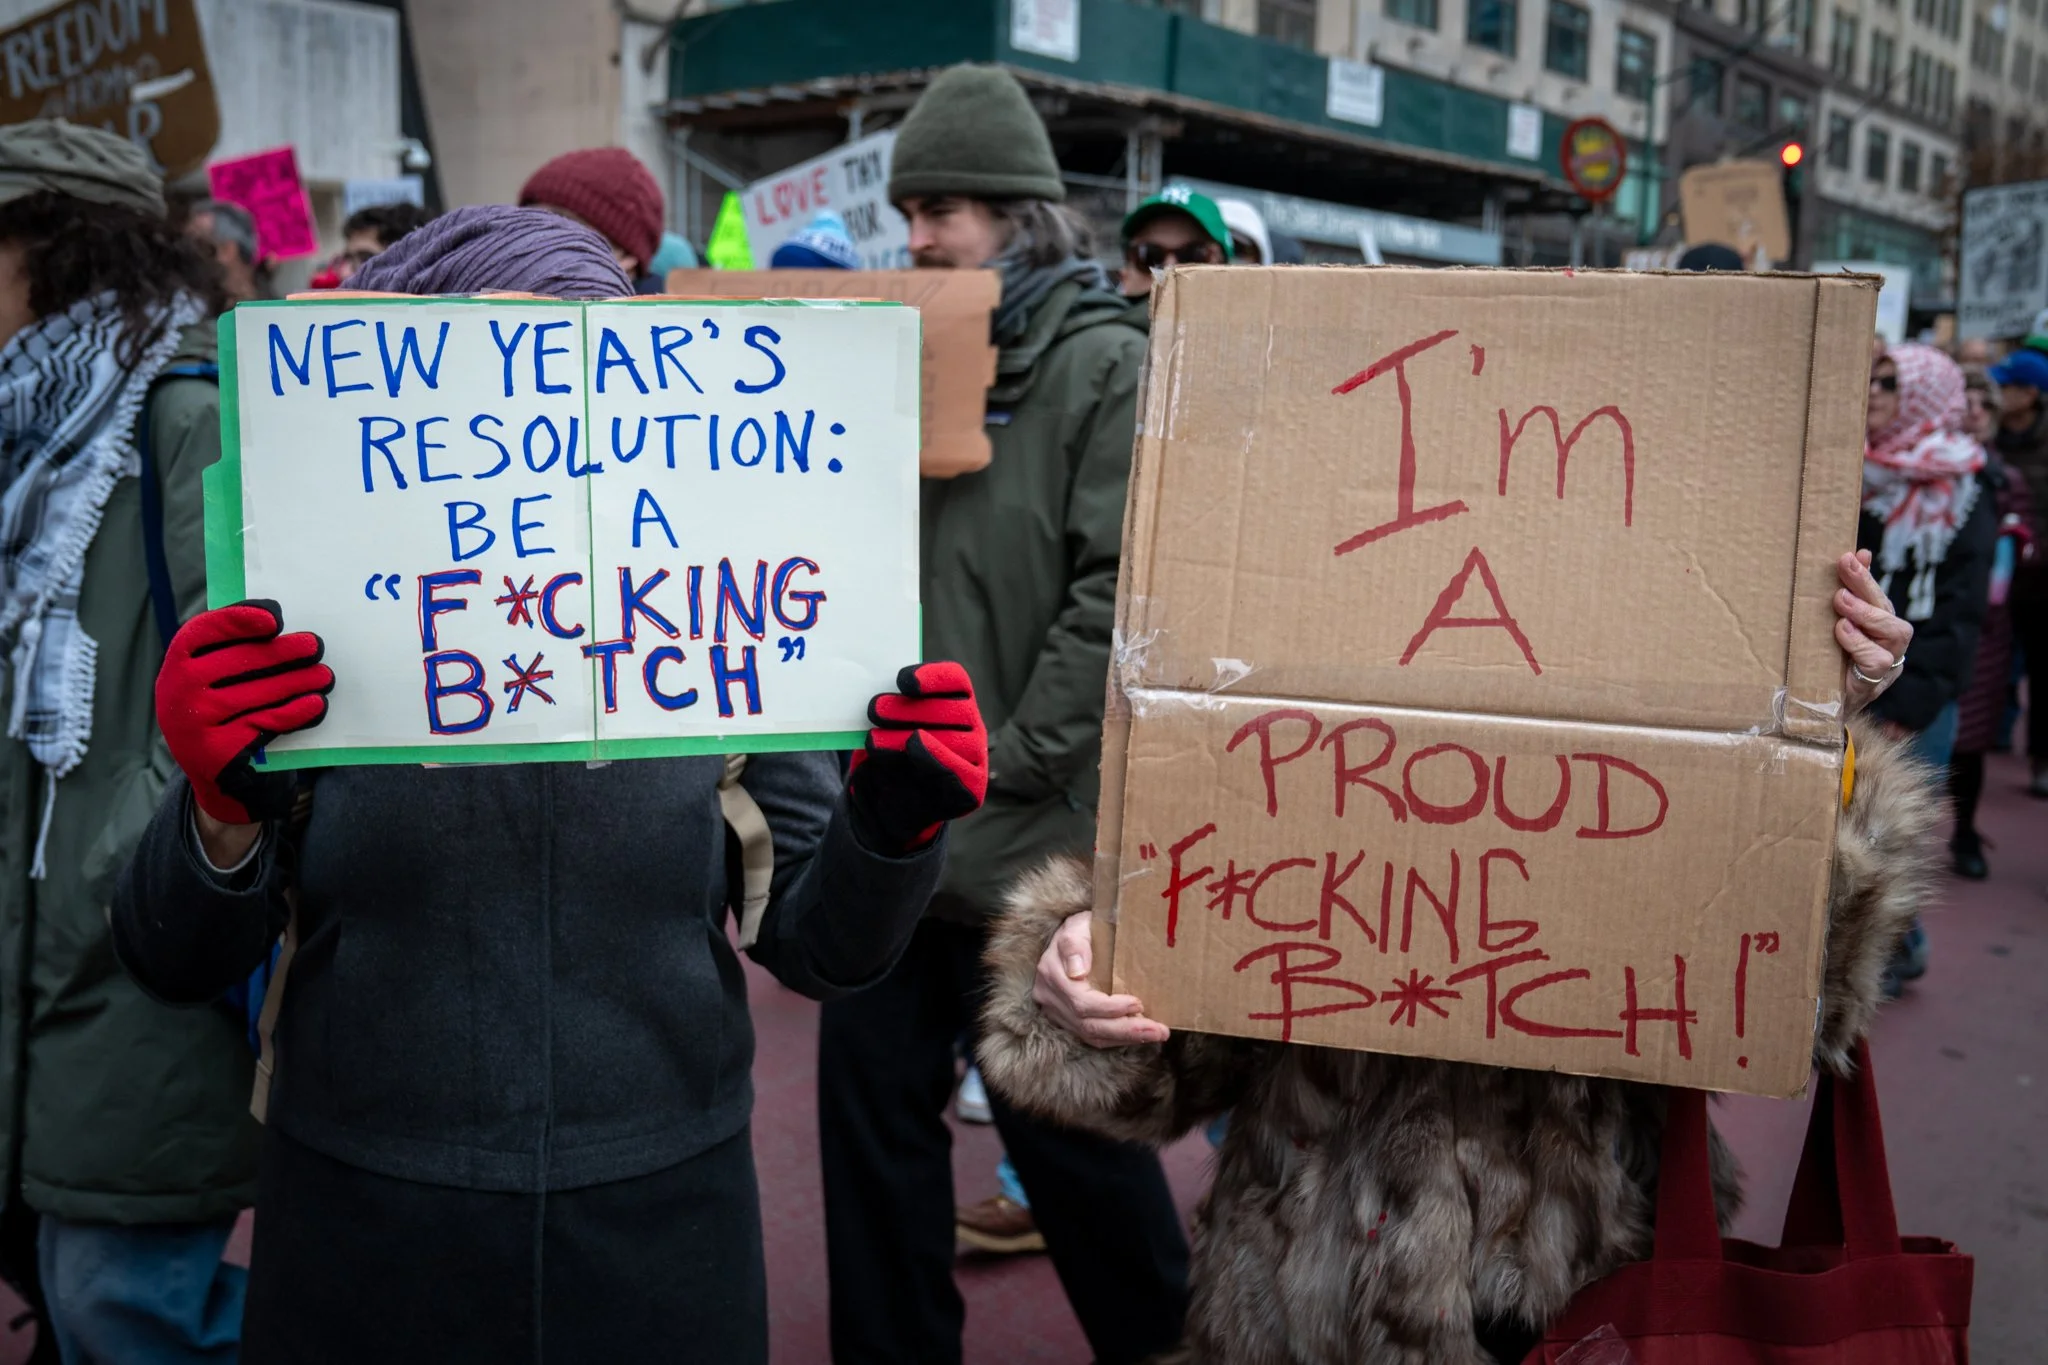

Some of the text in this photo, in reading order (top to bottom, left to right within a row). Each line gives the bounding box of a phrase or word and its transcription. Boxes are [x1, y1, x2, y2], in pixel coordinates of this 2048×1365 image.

[0, 0, 168, 99] REEDOM
[753, 166, 829, 225] LOVE
[267, 318, 787, 400] NEW YEAR'S
[358, 408, 847, 494] RESOLUTION:
[1331, 328, 1635, 557] I'm
[444, 487, 680, 563] BE A
[1400, 546, 1543, 676] A
[1226, 709, 1670, 840] PROUD
